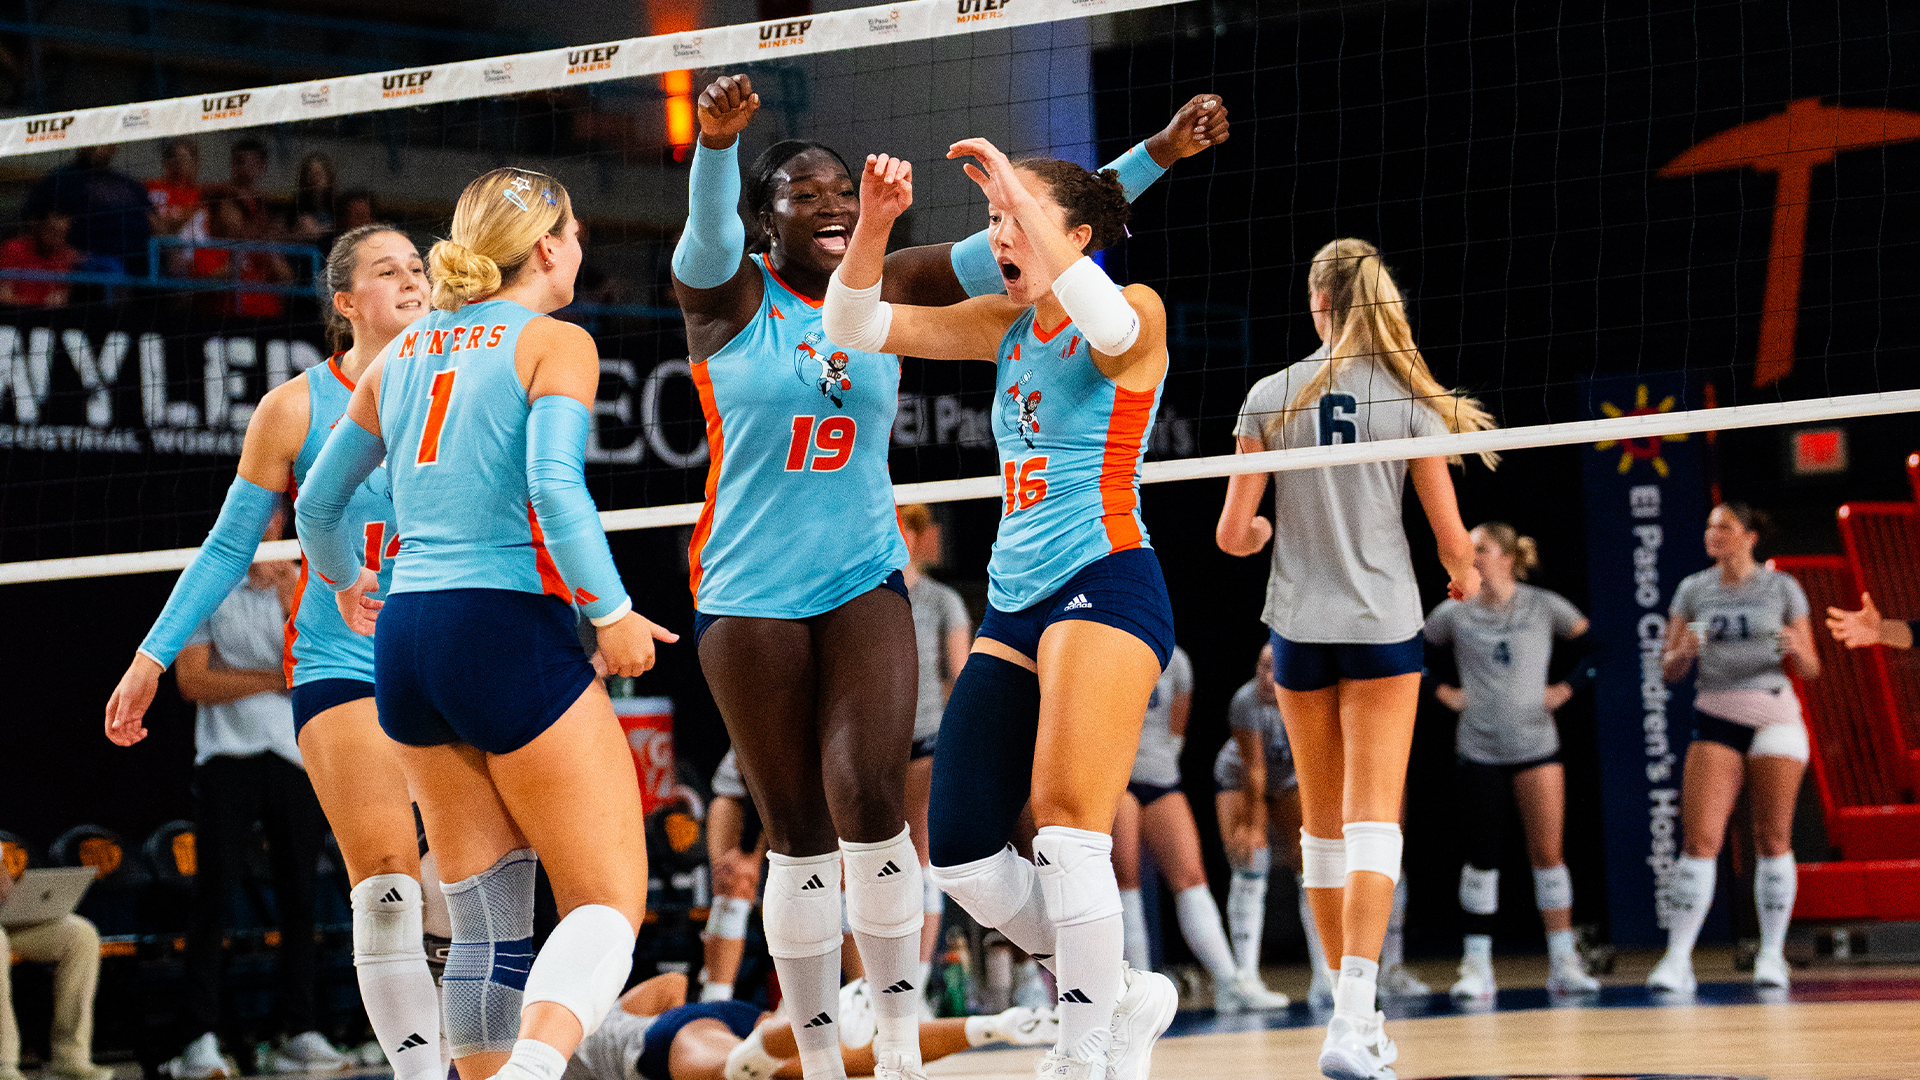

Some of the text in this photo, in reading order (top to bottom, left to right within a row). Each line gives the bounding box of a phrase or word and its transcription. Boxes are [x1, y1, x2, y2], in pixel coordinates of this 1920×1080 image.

[759, 19, 813, 40] UTEP
[956, 11, 1004, 23] MINERS
[567, 45, 619, 65] UTEP
[758, 37, 804, 49] MINERS
[382, 70, 433, 90] UTEP
[567, 62, 611, 74] MINERS
[202, 93, 251, 112] UTEP
[26, 116, 75, 135] UTEP
[397, 324, 509, 360] MINERS
[414, 366, 459, 468] 1
[1316, 390, 1360, 446] 6
[784, 415, 857, 472] 19
[1003, 455, 1050, 516] 16
[1629, 485, 1662, 518] El
[1633, 524, 1664, 608] Paso
[1707, 614, 1750, 641] 21
[1637, 612, 1678, 783] Children's
